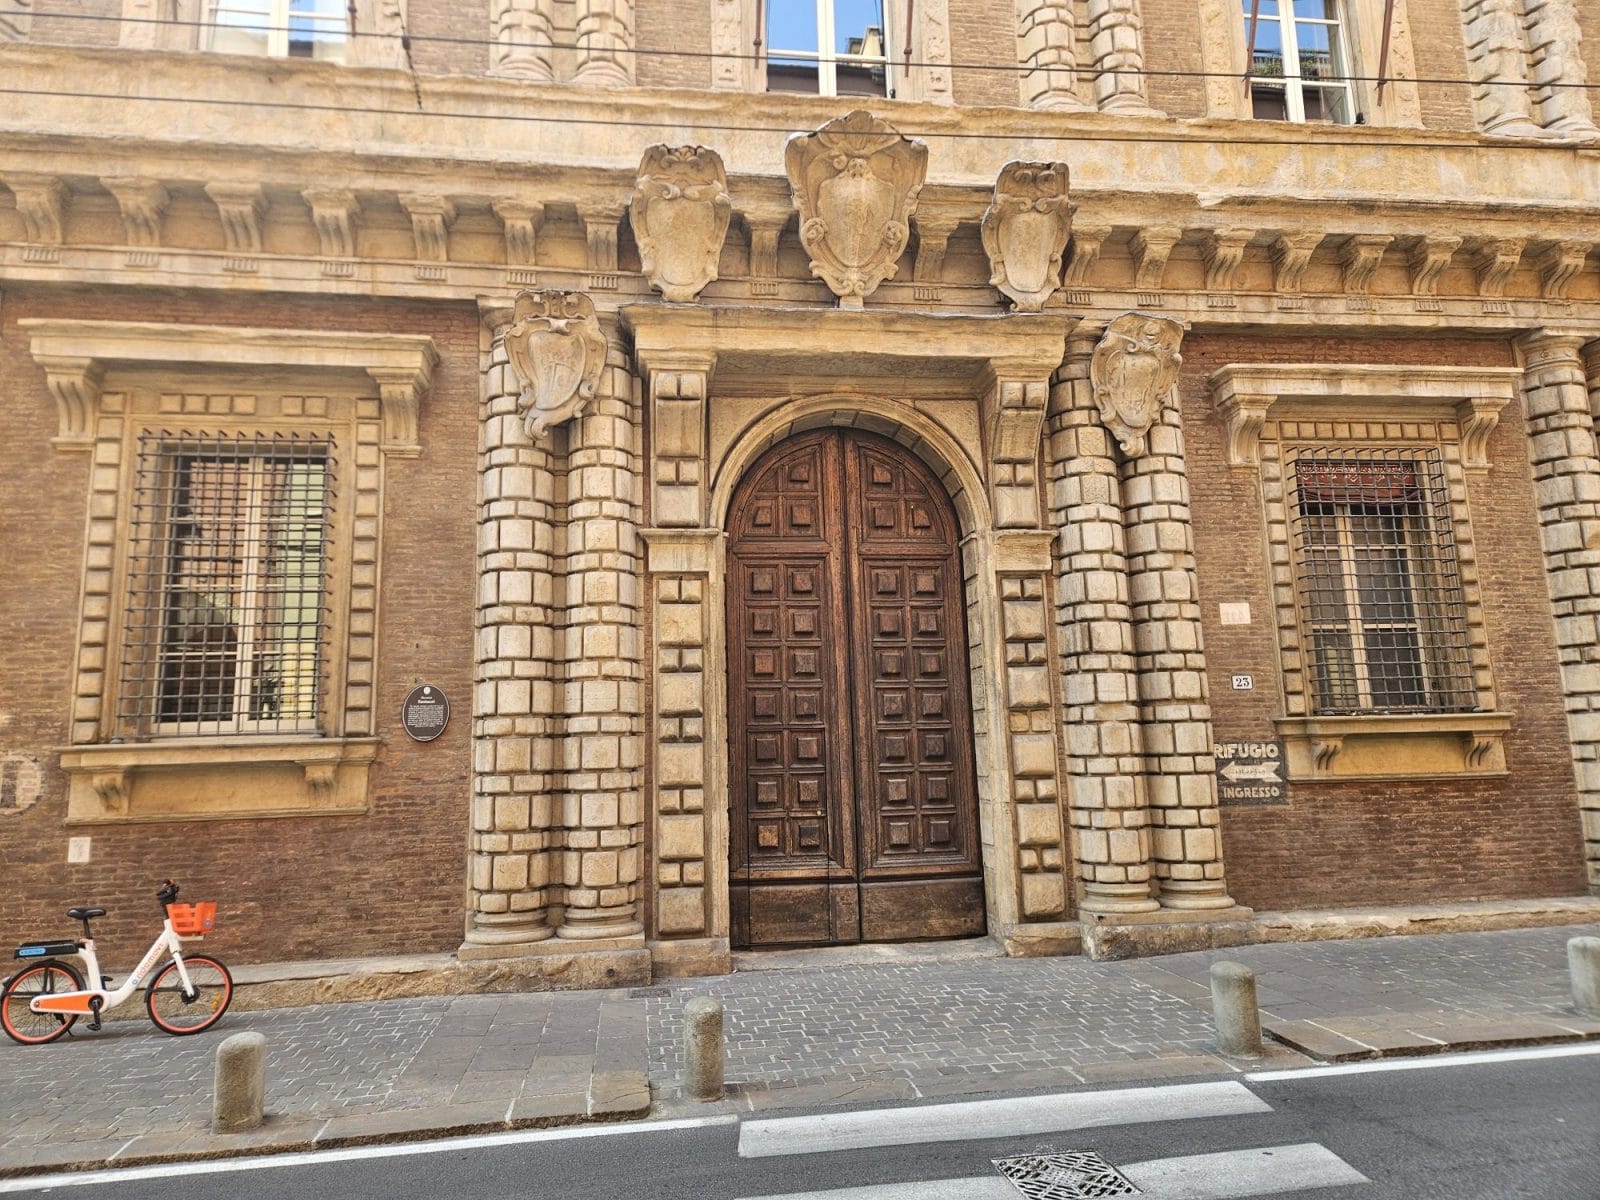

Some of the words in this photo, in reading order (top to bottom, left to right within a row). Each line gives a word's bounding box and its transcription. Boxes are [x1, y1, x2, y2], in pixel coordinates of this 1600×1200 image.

[1235, 677, 1250, 687] 23
[1213, 743, 1279, 759] RIFUGIO
[1223, 786, 1280, 799] INGRESSO
